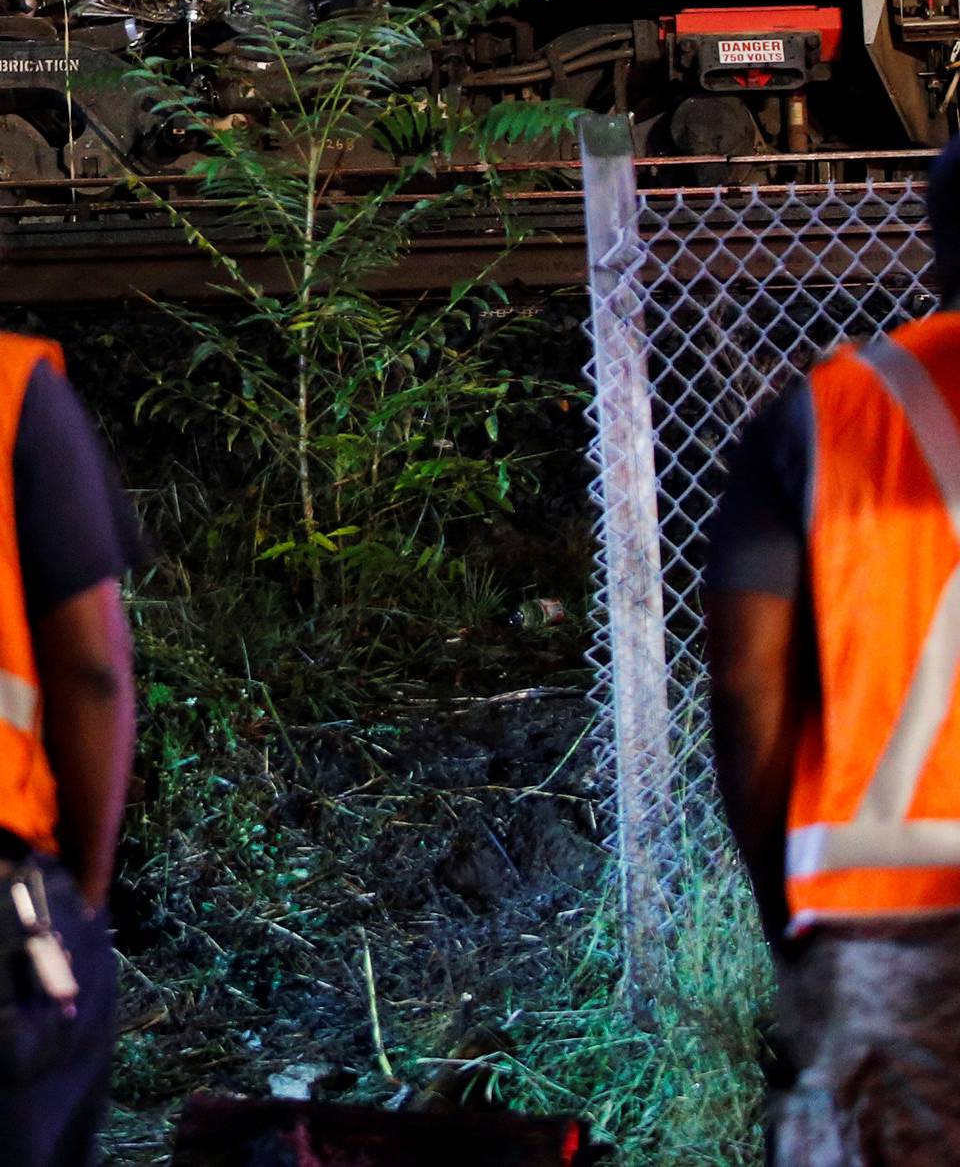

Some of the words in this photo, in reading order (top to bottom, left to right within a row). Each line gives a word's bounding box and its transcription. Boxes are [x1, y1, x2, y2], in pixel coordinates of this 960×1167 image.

[721, 41, 781, 52] DANGER
[723, 54, 744, 62] 750
[747, 53, 782, 62] VOLTS
